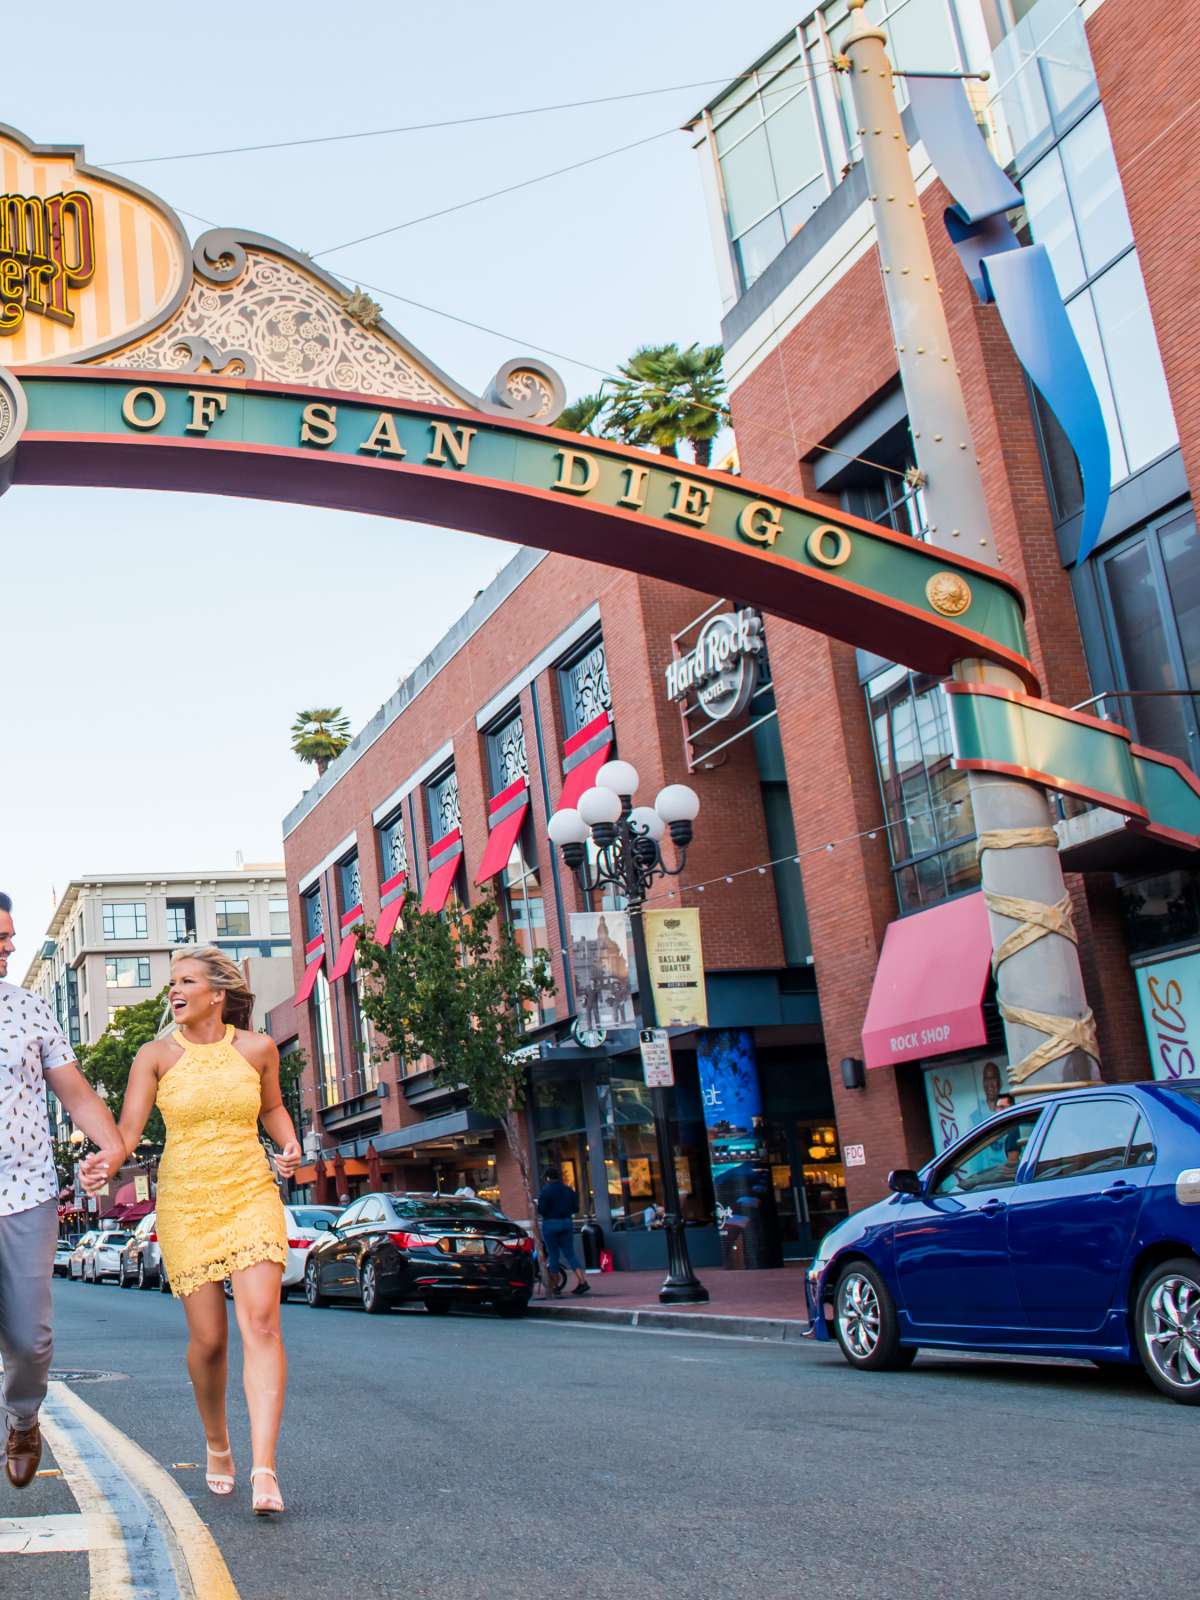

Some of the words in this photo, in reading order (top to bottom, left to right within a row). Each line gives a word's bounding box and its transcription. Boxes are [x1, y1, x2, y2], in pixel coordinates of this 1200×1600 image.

[121, 386, 227, 433] OF
[300, 403, 478, 468] SAN
[552, 448, 851, 568] DIEGO
[665, 637, 705, 701] Hard
[708, 608, 751, 672] Rock
[658, 955, 691, 963] GASLAMP
[660, 964, 691, 972] QUARTER
[890, 1034, 918, 1052] ROCK
[921, 1024, 951, 1045] SHOP
[846, 1146, 864, 1158] FDC
